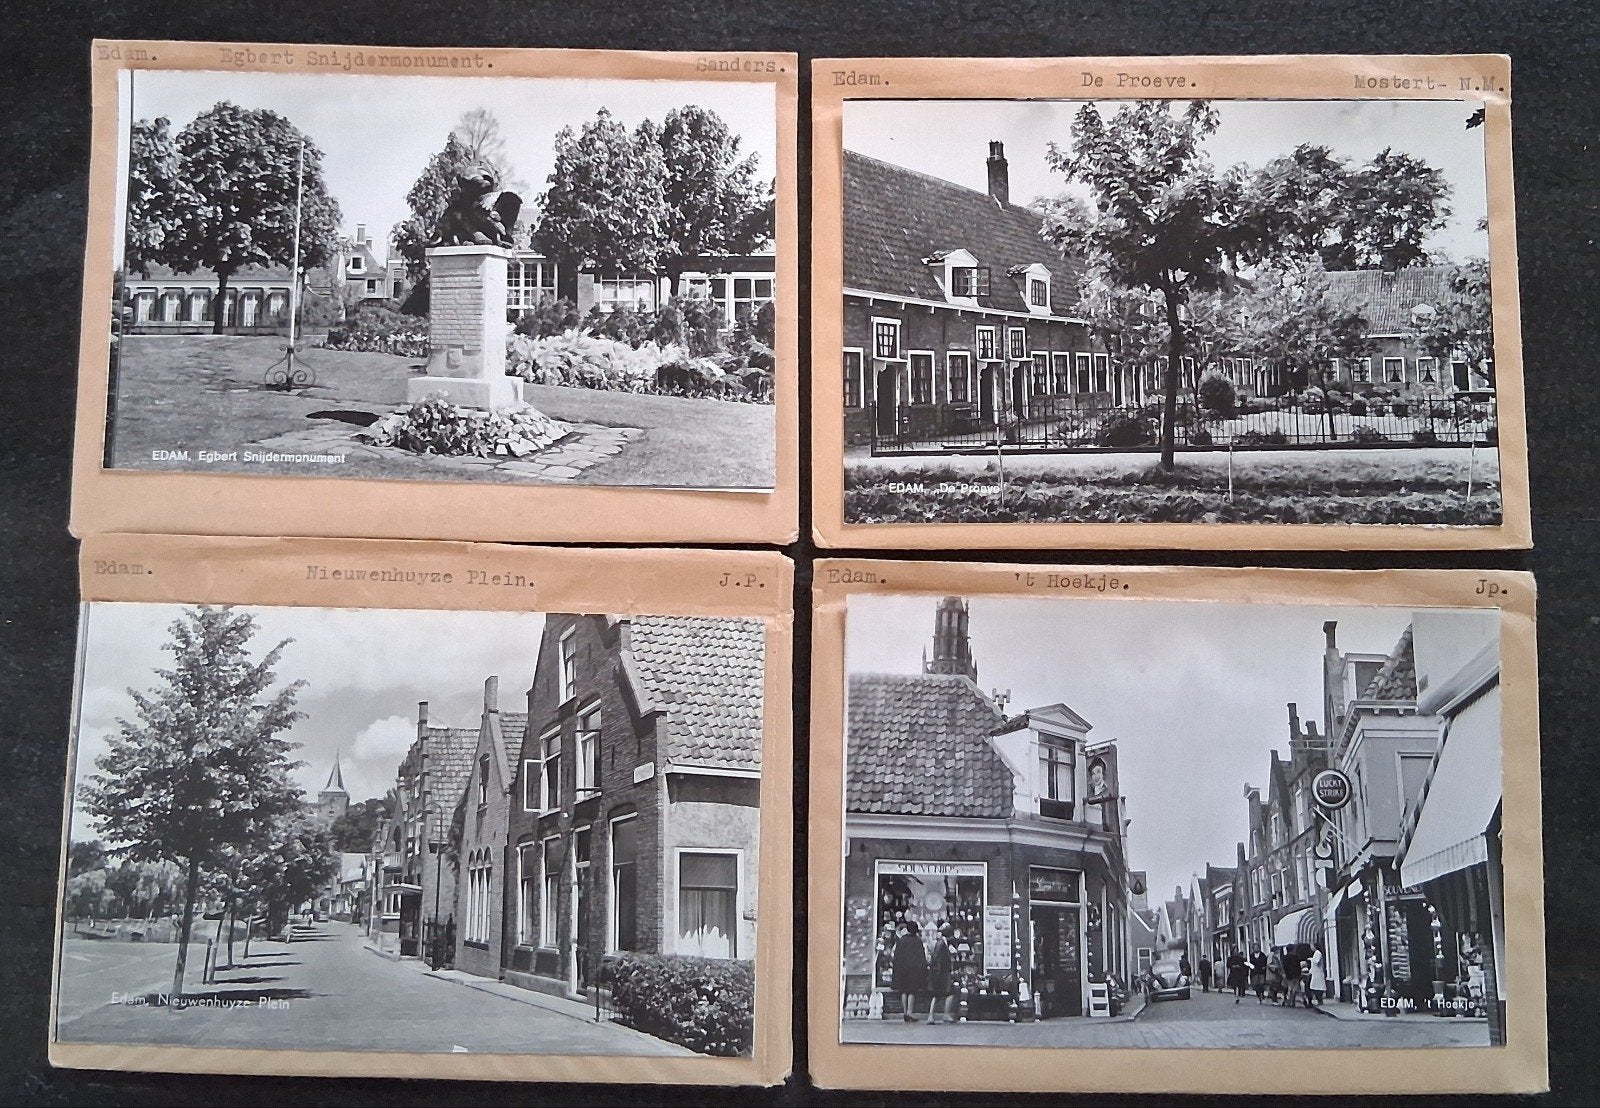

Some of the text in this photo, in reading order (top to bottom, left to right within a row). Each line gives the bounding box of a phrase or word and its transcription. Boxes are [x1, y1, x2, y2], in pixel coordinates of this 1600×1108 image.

[96, 45, 157, 61] Edam.
[219, 48, 493, 70] Egbert Snijdermonument.
[696, 57, 786, 73] Sanders.
[832, 71, 890, 86] Edam.
[1081, 72, 1196, 88] De Proeve.
[1460, 76, 1504, 91] N.M.
[152, 450, 346, 466] EDAM, Egbert Snijdermonument
[93, 560, 153, 577] Edam.
[306, 566, 535, 587] Nieuwenhuyze Plein.
[827, 568, 887, 584] Edam.
[719, 573, 764, 588] J.P.
[1015, 572, 1129, 592] 't Hoekje.
[1476, 579, 1508, 597] Jp.
[1319, 779, 1342, 788] LUCKY
[1319, 787, 1344, 799] STRIKE
[111, 992, 290, 1010] Edam, Nieuwenhuyze Plein
[1380, 997, 1475, 1012] EDAM, 't Hoekje
